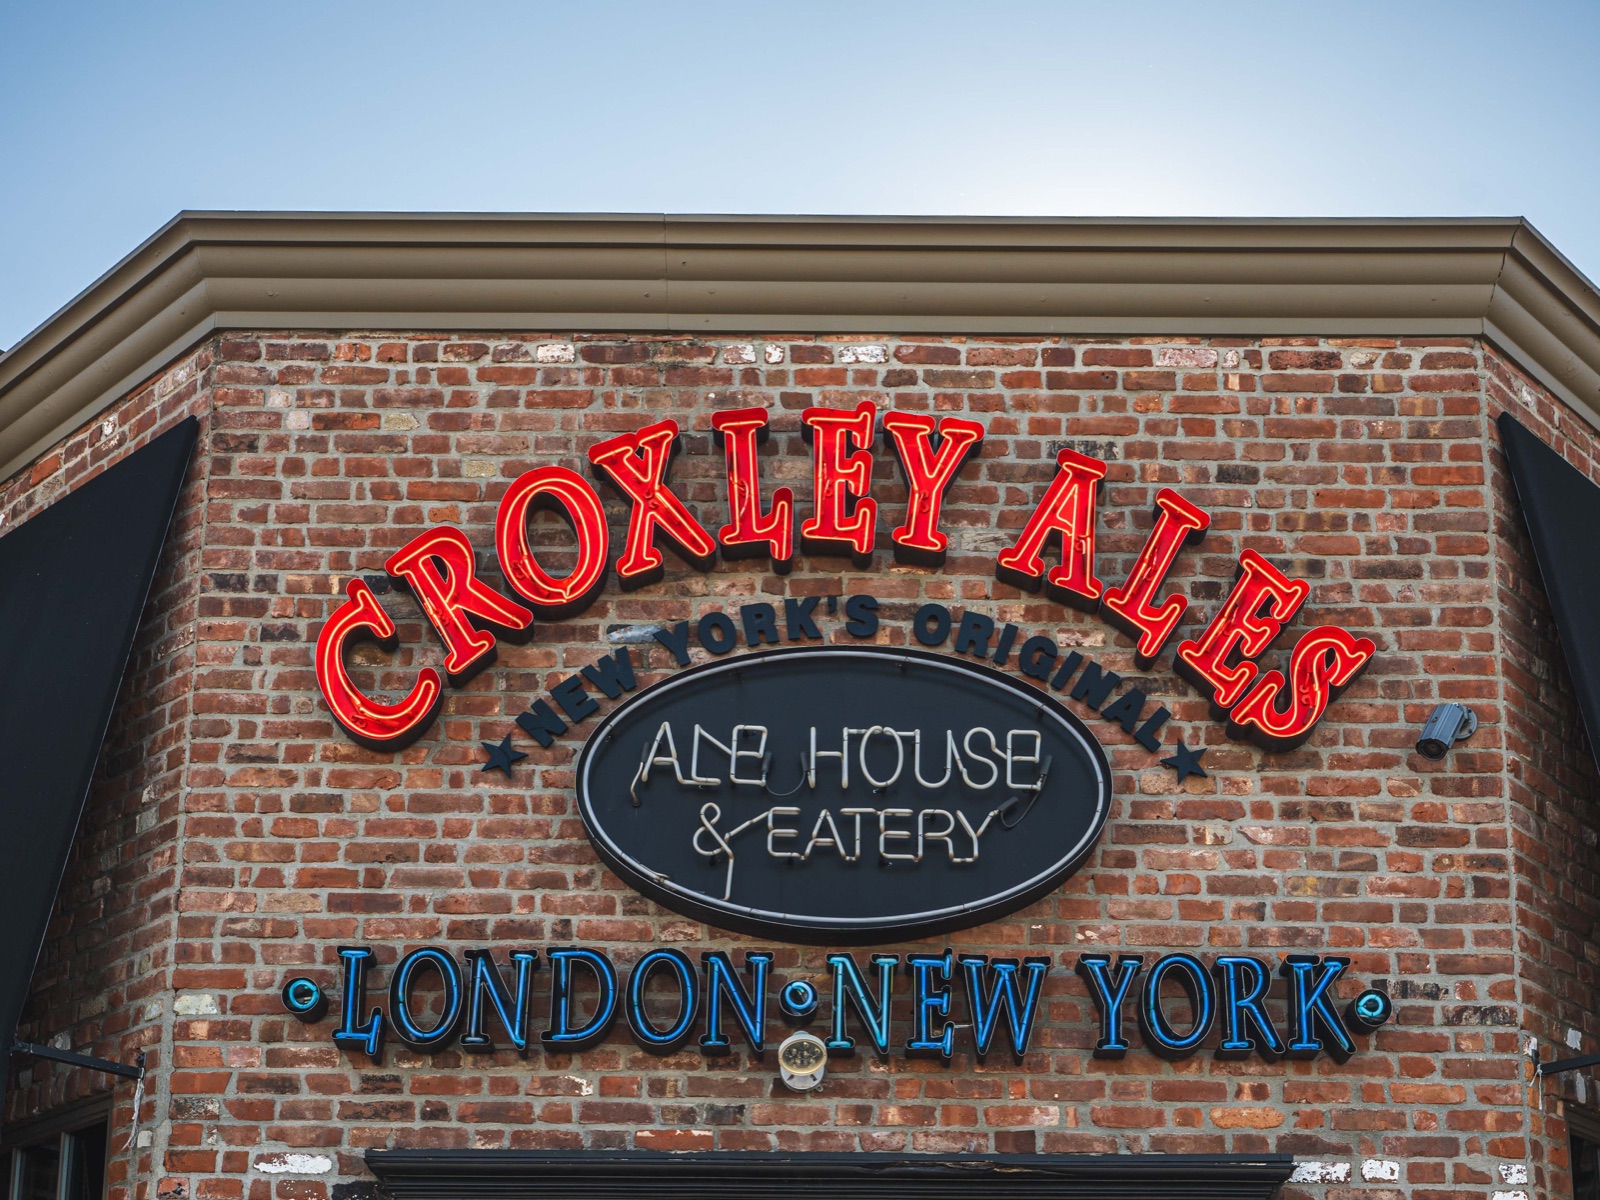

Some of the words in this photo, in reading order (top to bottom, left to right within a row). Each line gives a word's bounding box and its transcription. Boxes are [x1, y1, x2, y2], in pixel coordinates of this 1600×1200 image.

[315, 401, 984, 748] CROXLEY
[997, 448, 1376, 745] ALES
[515, 646, 638, 747] NEW
[653, 595, 879, 666] YORK'S
[914, 603, 1173, 752] ORIGINAL
[641, 721, 769, 787] ALE
[807, 725, 1043, 790] HOUSE
[693, 802, 735, 875] &
[767, 806, 1000, 863] EATERY
[331, 945, 774, 1062] LONDON
[825, 946, 1053, 1067] NEW
[1077, 952, 1357, 1063] YORK
